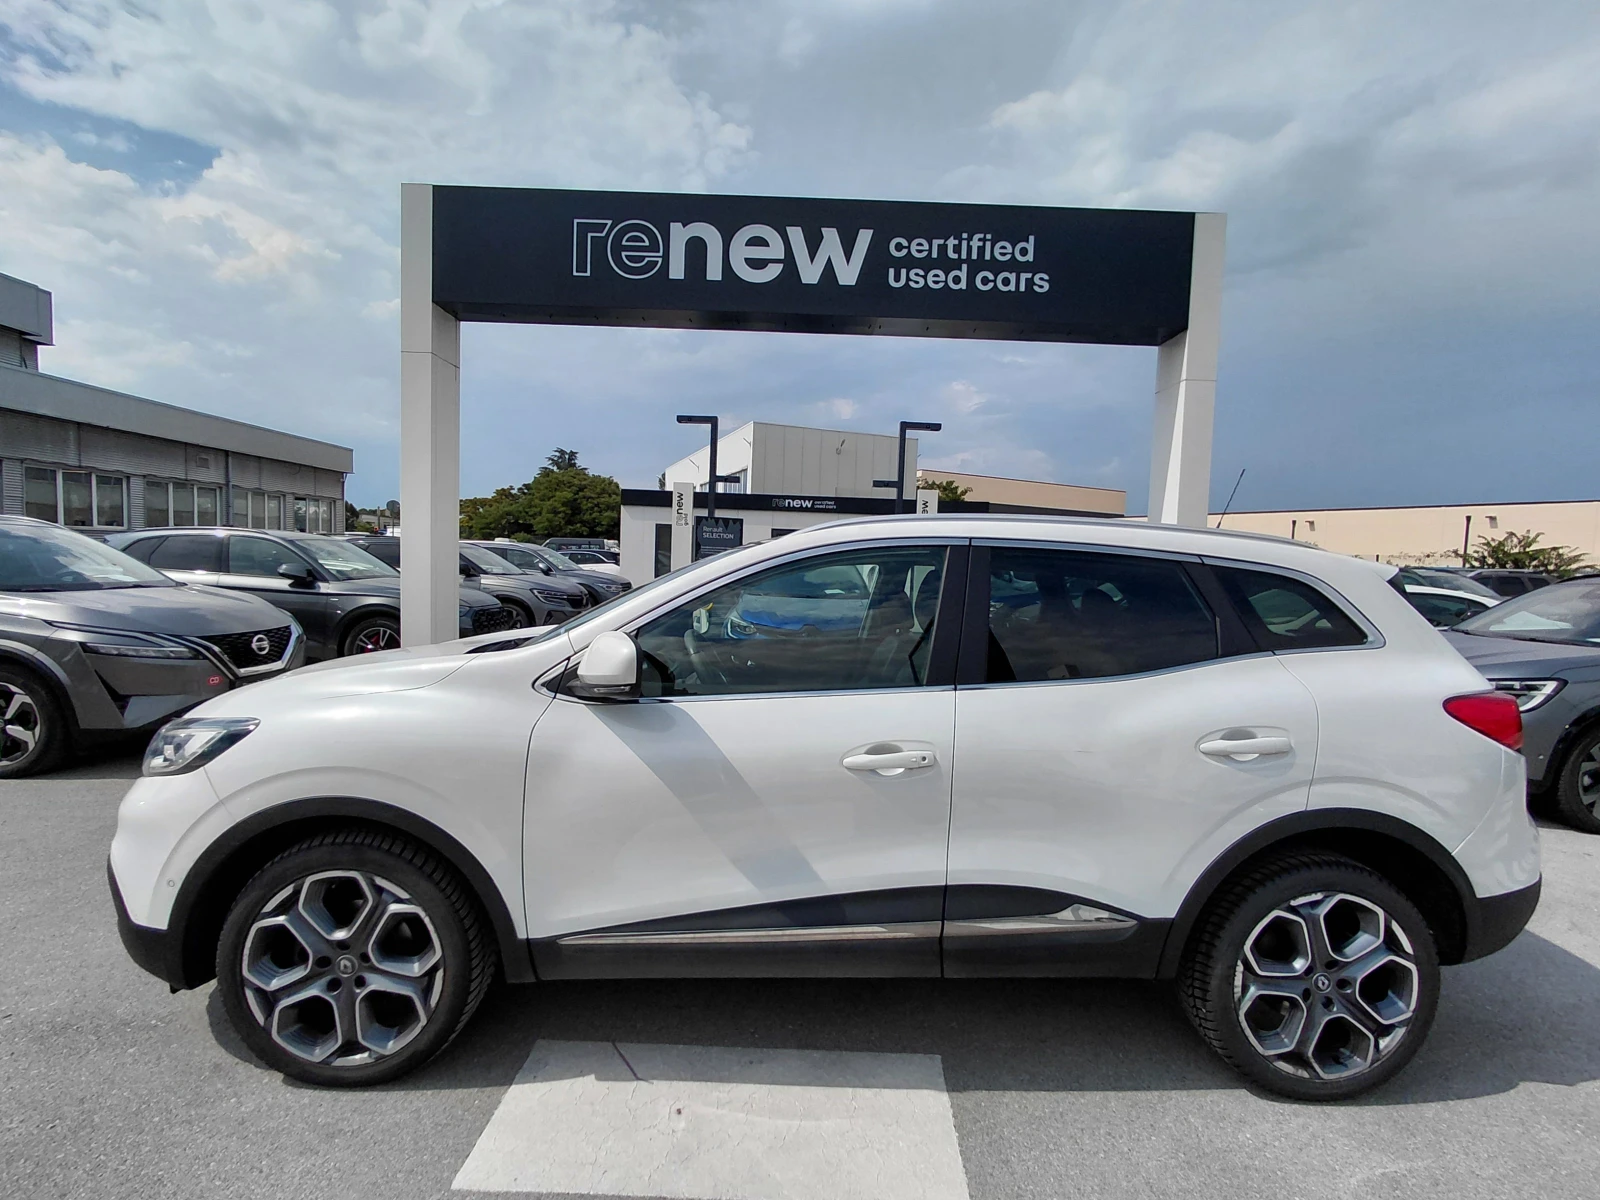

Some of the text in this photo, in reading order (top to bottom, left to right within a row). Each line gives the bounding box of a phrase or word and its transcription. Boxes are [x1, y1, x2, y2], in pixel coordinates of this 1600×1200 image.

[572, 217, 874, 286] renew
[888, 232, 1035, 263] certified
[887, 264, 1050, 293] used cars
[771, 498, 813, 508] renew
[702, 532, 734, 540] SELECTION
